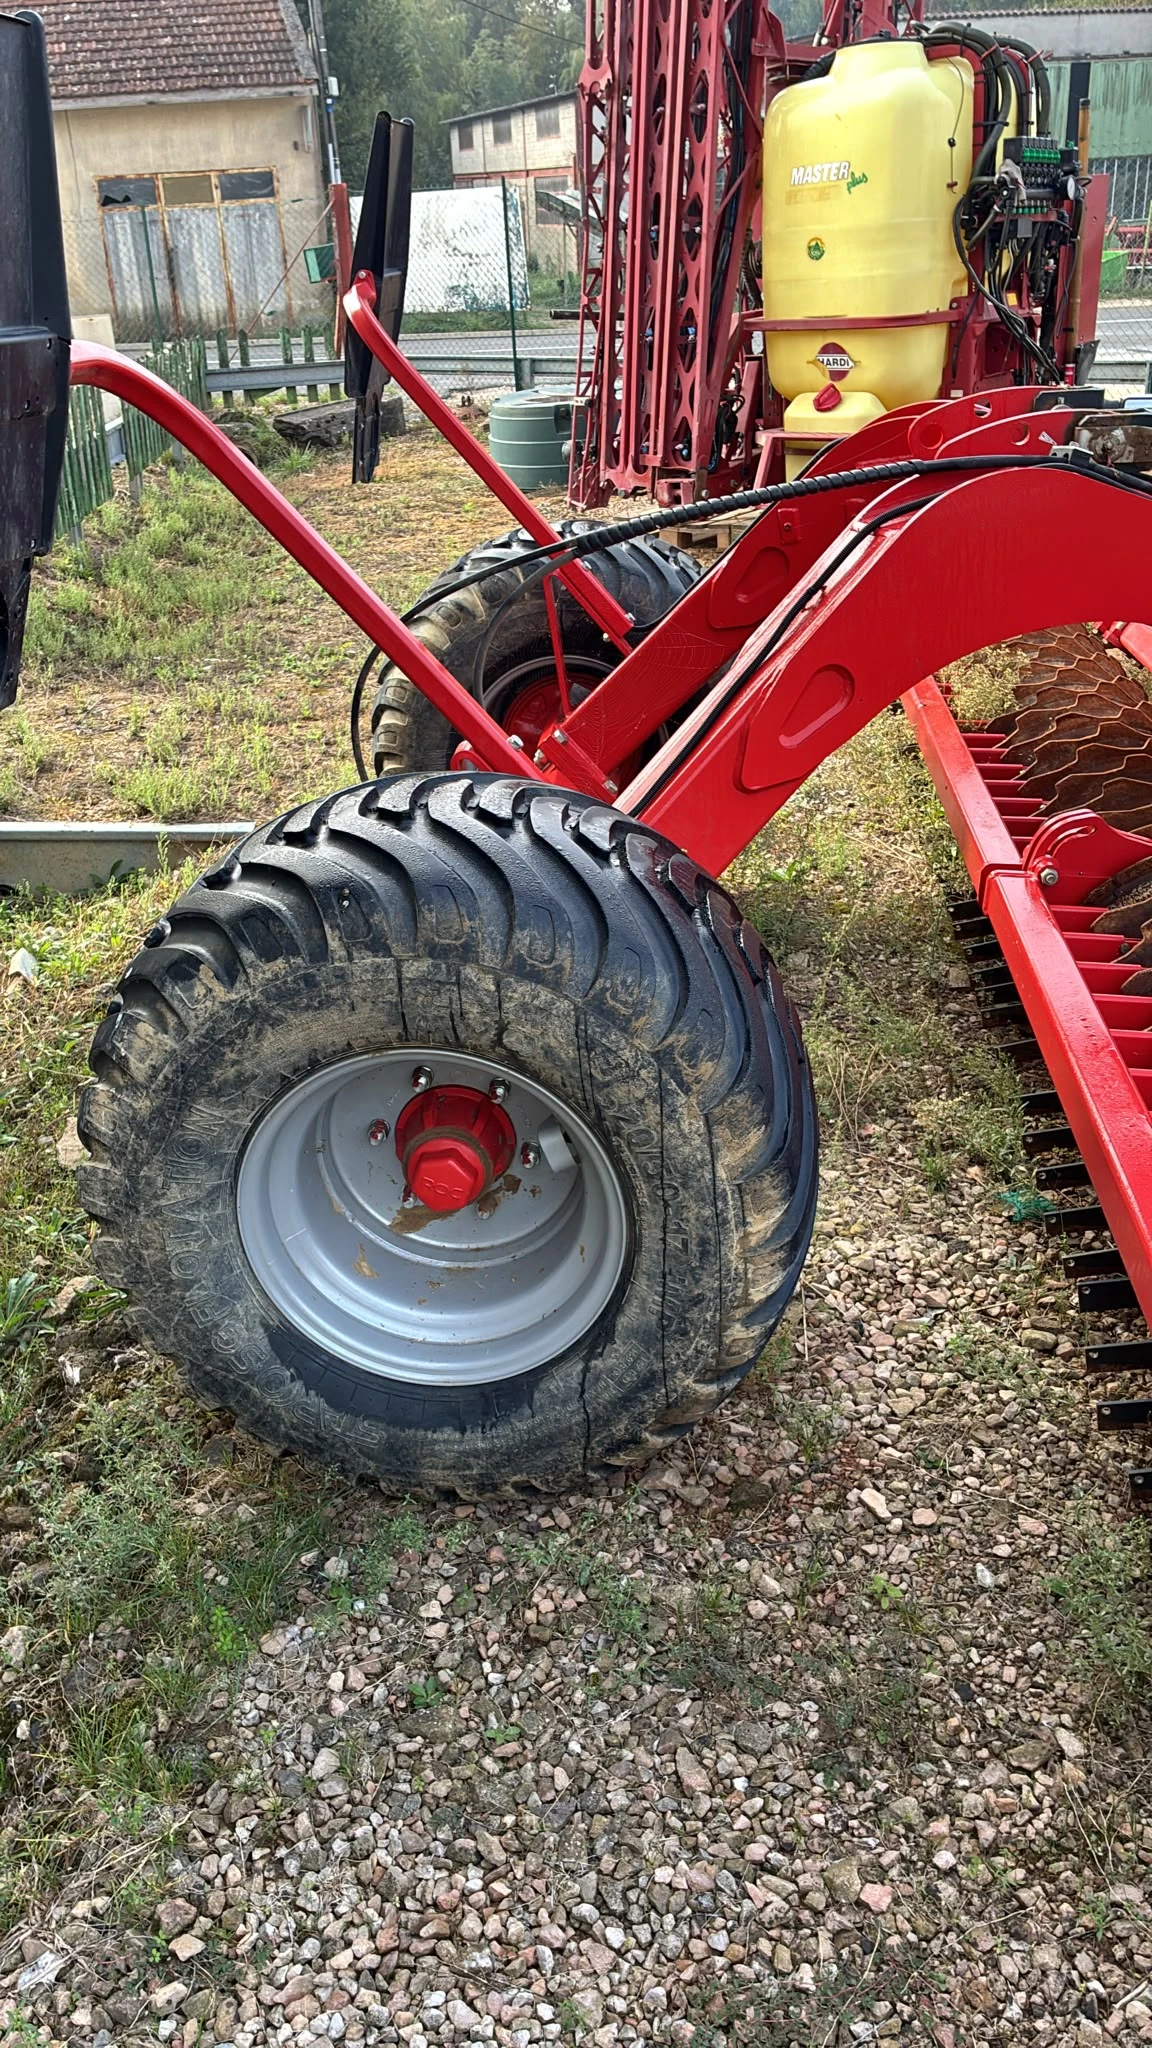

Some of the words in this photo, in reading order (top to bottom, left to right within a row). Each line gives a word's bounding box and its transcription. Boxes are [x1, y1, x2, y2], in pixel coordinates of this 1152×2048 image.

[791, 161, 850, 185] MASTER
[846, 171, 869, 194] plus
[817, 358, 850, 367] HARDI
[423, 1176, 465, 1201] ROC
